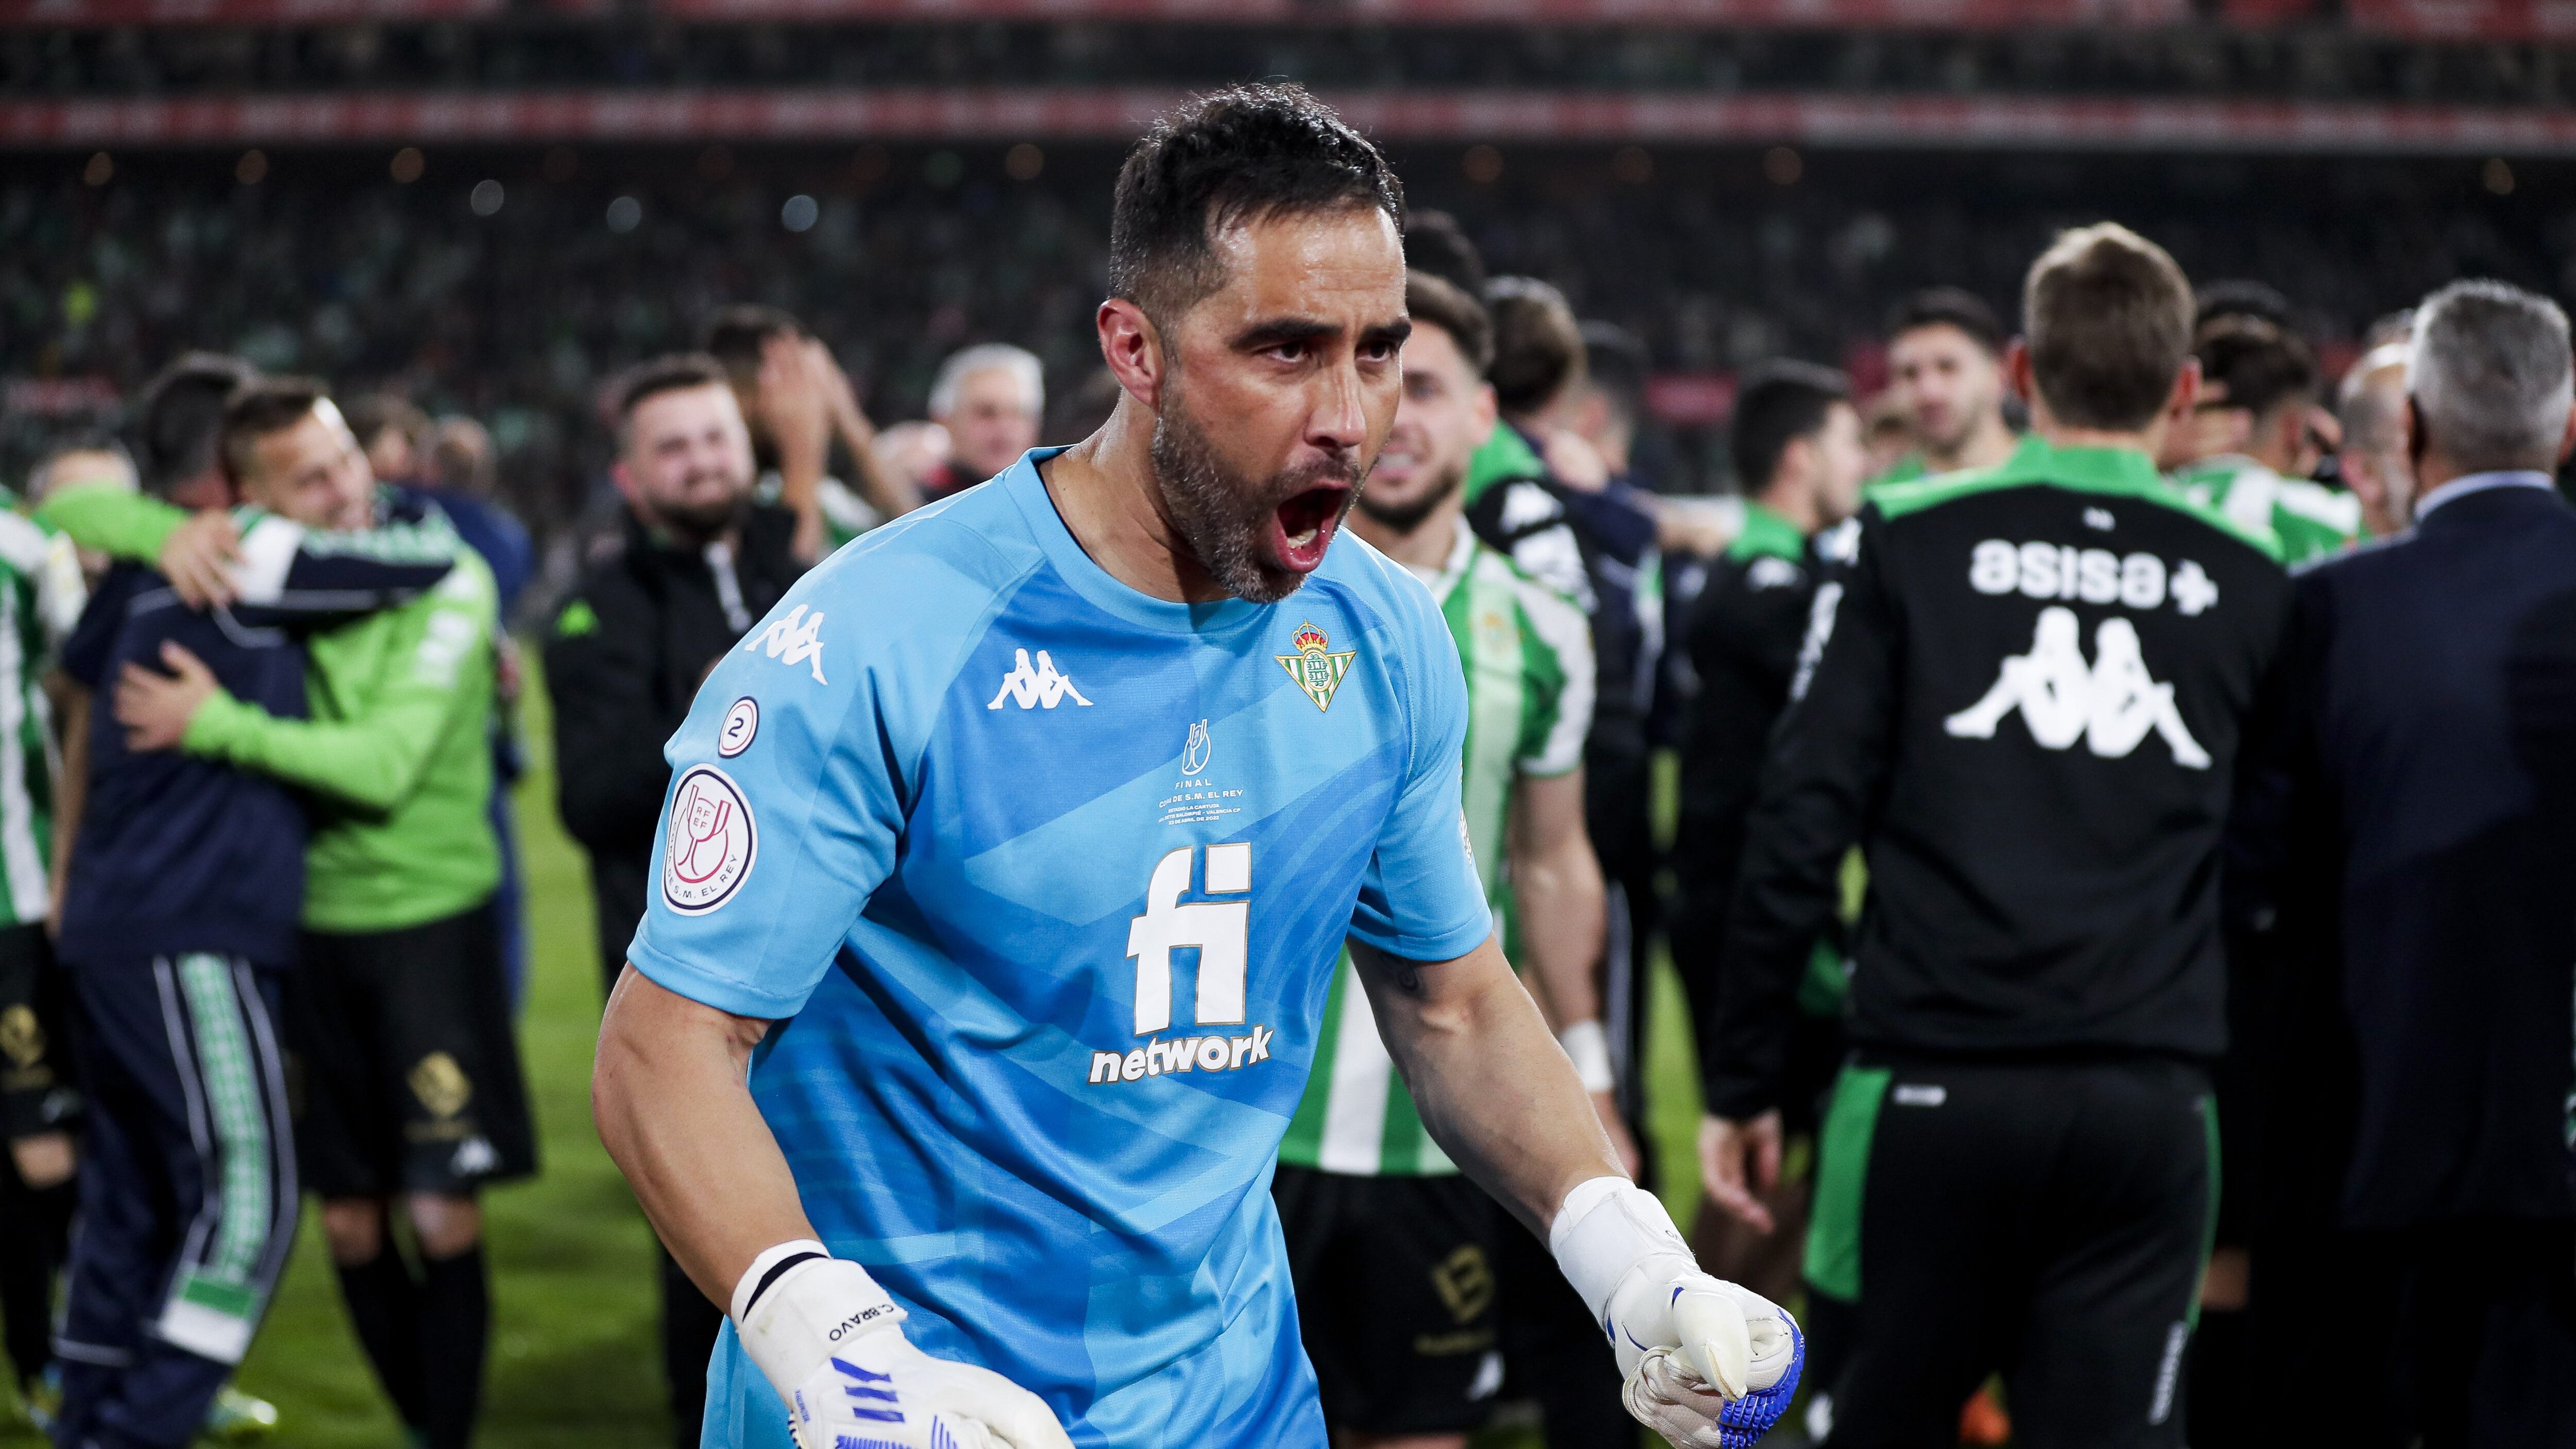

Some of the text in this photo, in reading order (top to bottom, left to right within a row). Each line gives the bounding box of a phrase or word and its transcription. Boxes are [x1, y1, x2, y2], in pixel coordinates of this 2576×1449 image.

[727, 717, 744, 738] 2
[1175, 778, 1212, 790] FINAL
[1223, 789, 1243, 797] REY
[674, 885, 696, 899] S.M.
[702, 885, 717, 896] EL
[720, 854, 737, 883] REY
[1126, 842, 1251, 1036] fi
[1087, 1025, 1274, 1085] network
